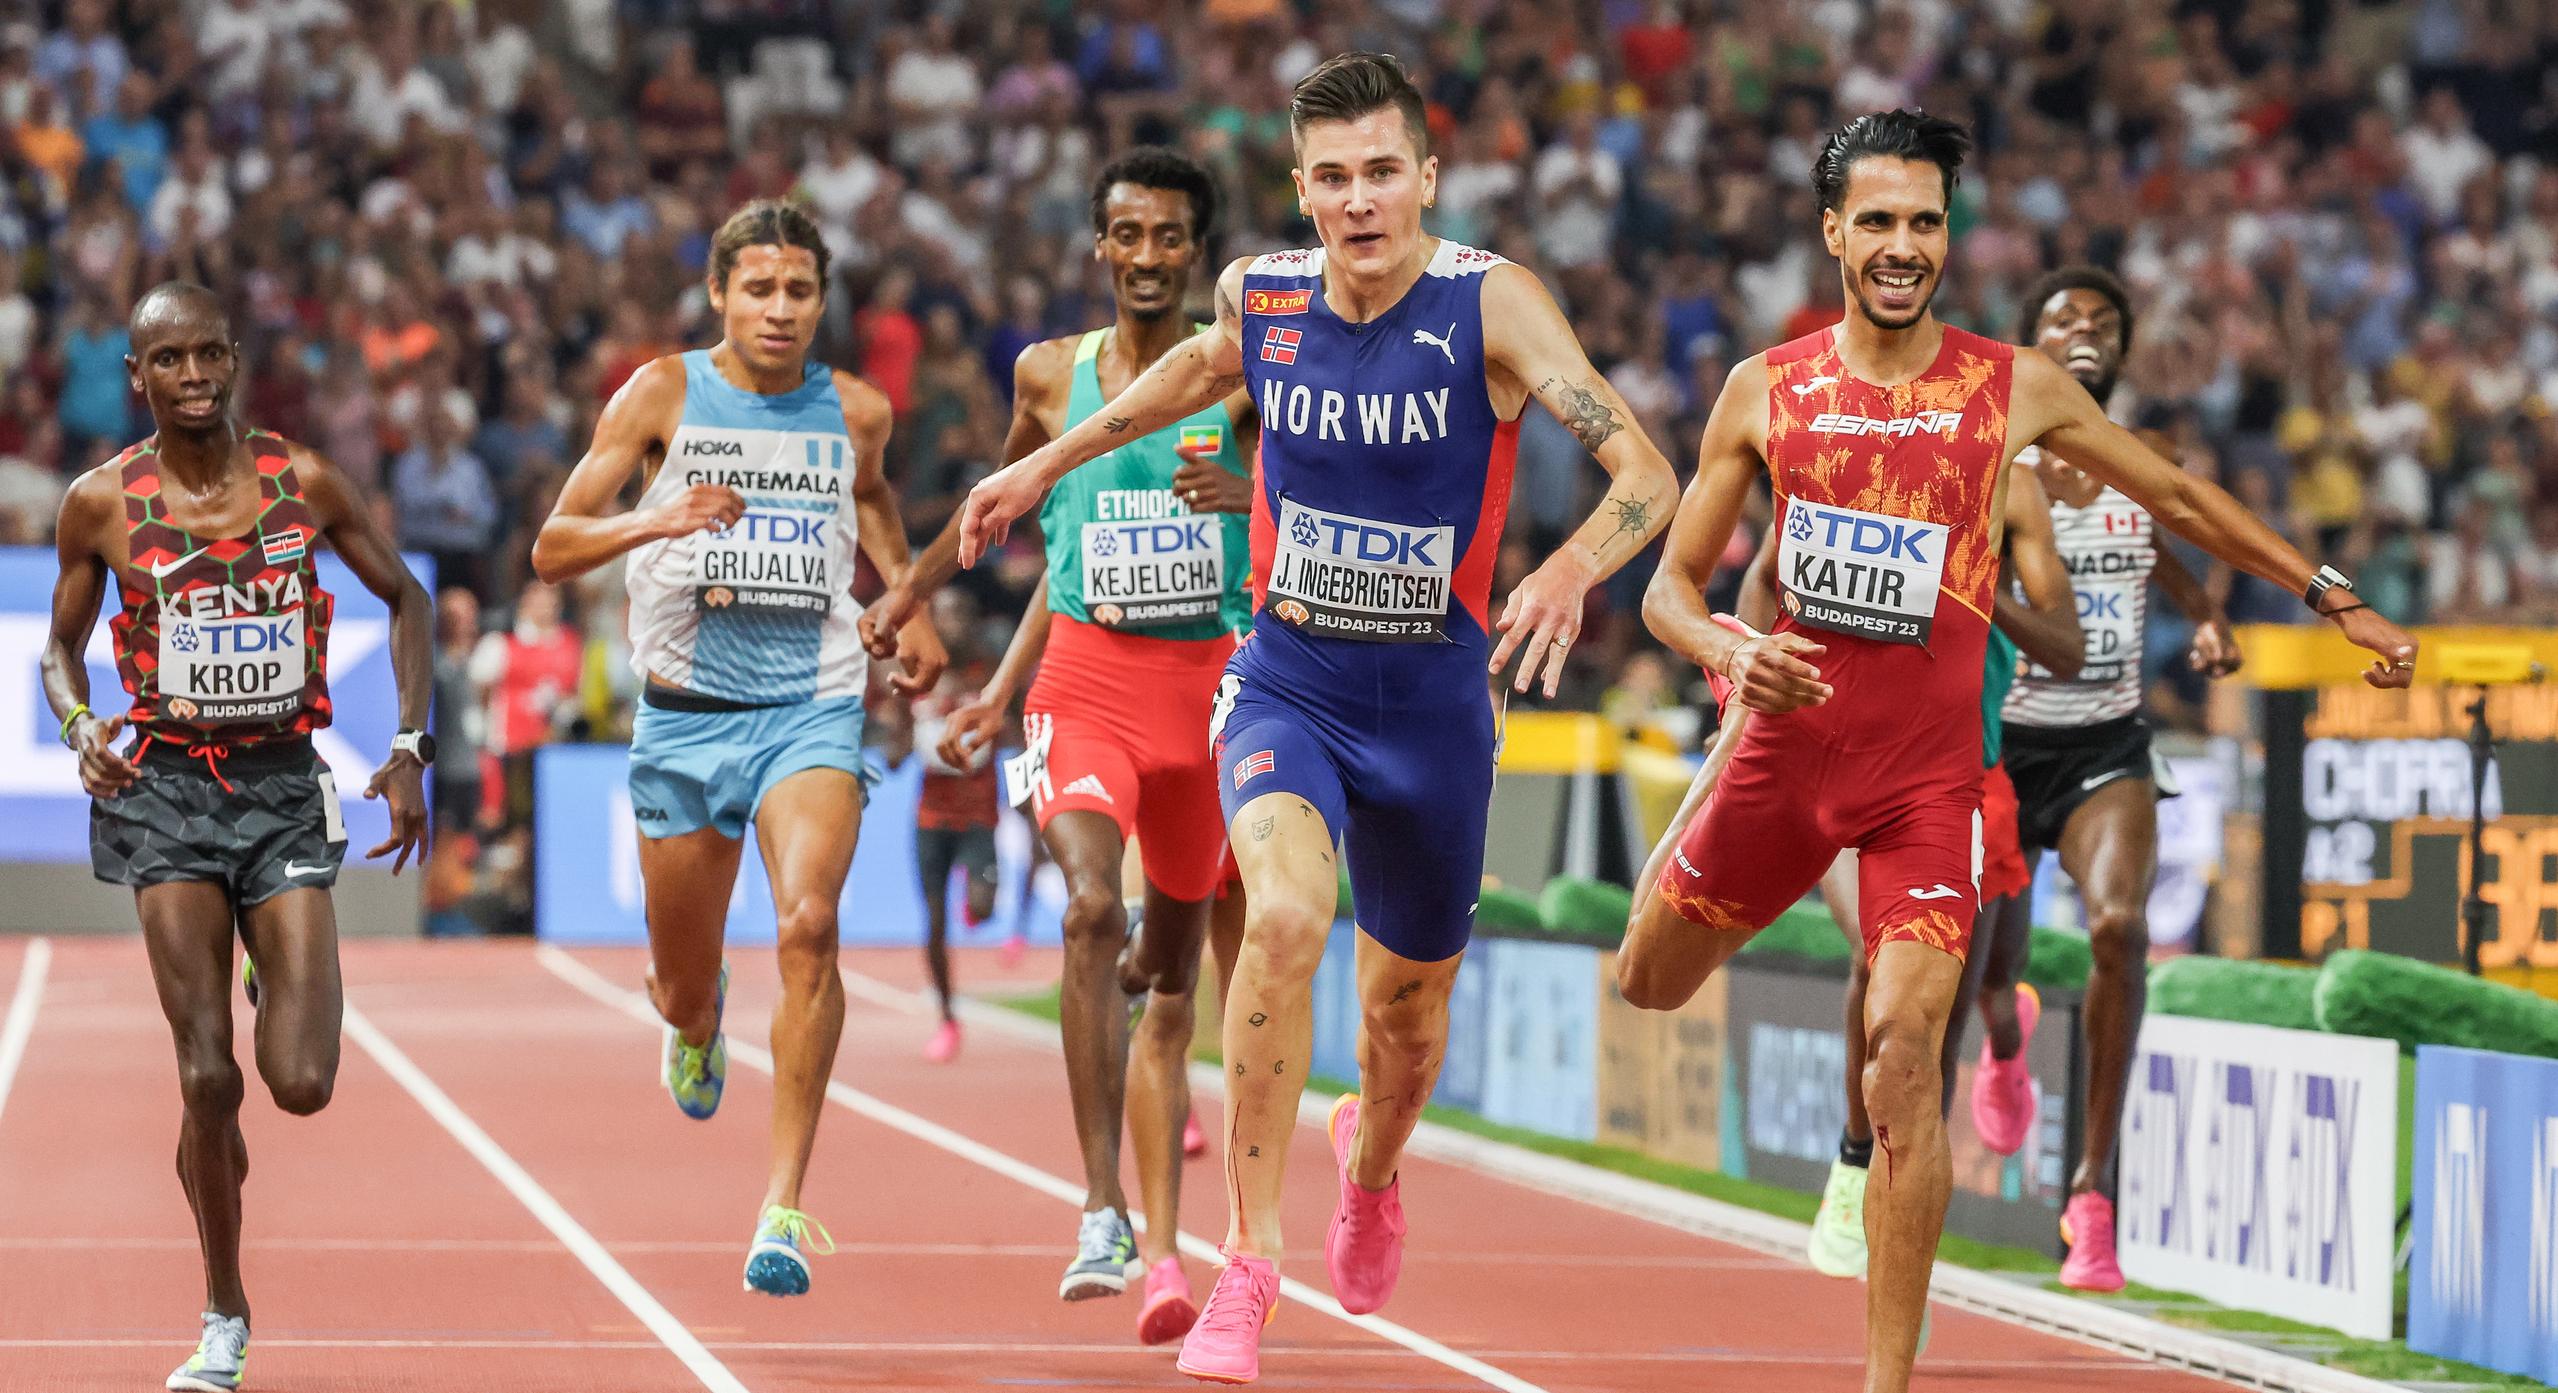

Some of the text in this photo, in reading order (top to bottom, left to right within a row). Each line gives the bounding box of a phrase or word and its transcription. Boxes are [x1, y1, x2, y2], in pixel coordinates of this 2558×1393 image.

[1272, 296, 1305, 309] EXTRA
[1263, 378, 1450, 445] NORWAY
[1808, 410, 1964, 437] ESPAÑA
[683, 440, 743, 457] HOKA
[686, 470, 841, 497] GUATEMALA
[1097, 489, 1191, 520] ETHIOPI
[743, 514, 826, 548] TDK
[1118, 522, 1211, 555] TDK
[1320, 518, 1440, 567] TDK
[1815, 510, 1933, 564] TDK
[705, 551, 827, 588] GRIJALVA
[1092, 559, 1218, 597] KEJELCHA
[1277, 553, 1443, 610] J. INGEBRIGTSEN
[1793, 551, 1905, 608] KATIR
[156, 571, 305, 620] KENYA
[199, 618, 295, 655] TDK
[189, 662, 282, 695] KROP
[1675, 846, 1703, 878] ESP
